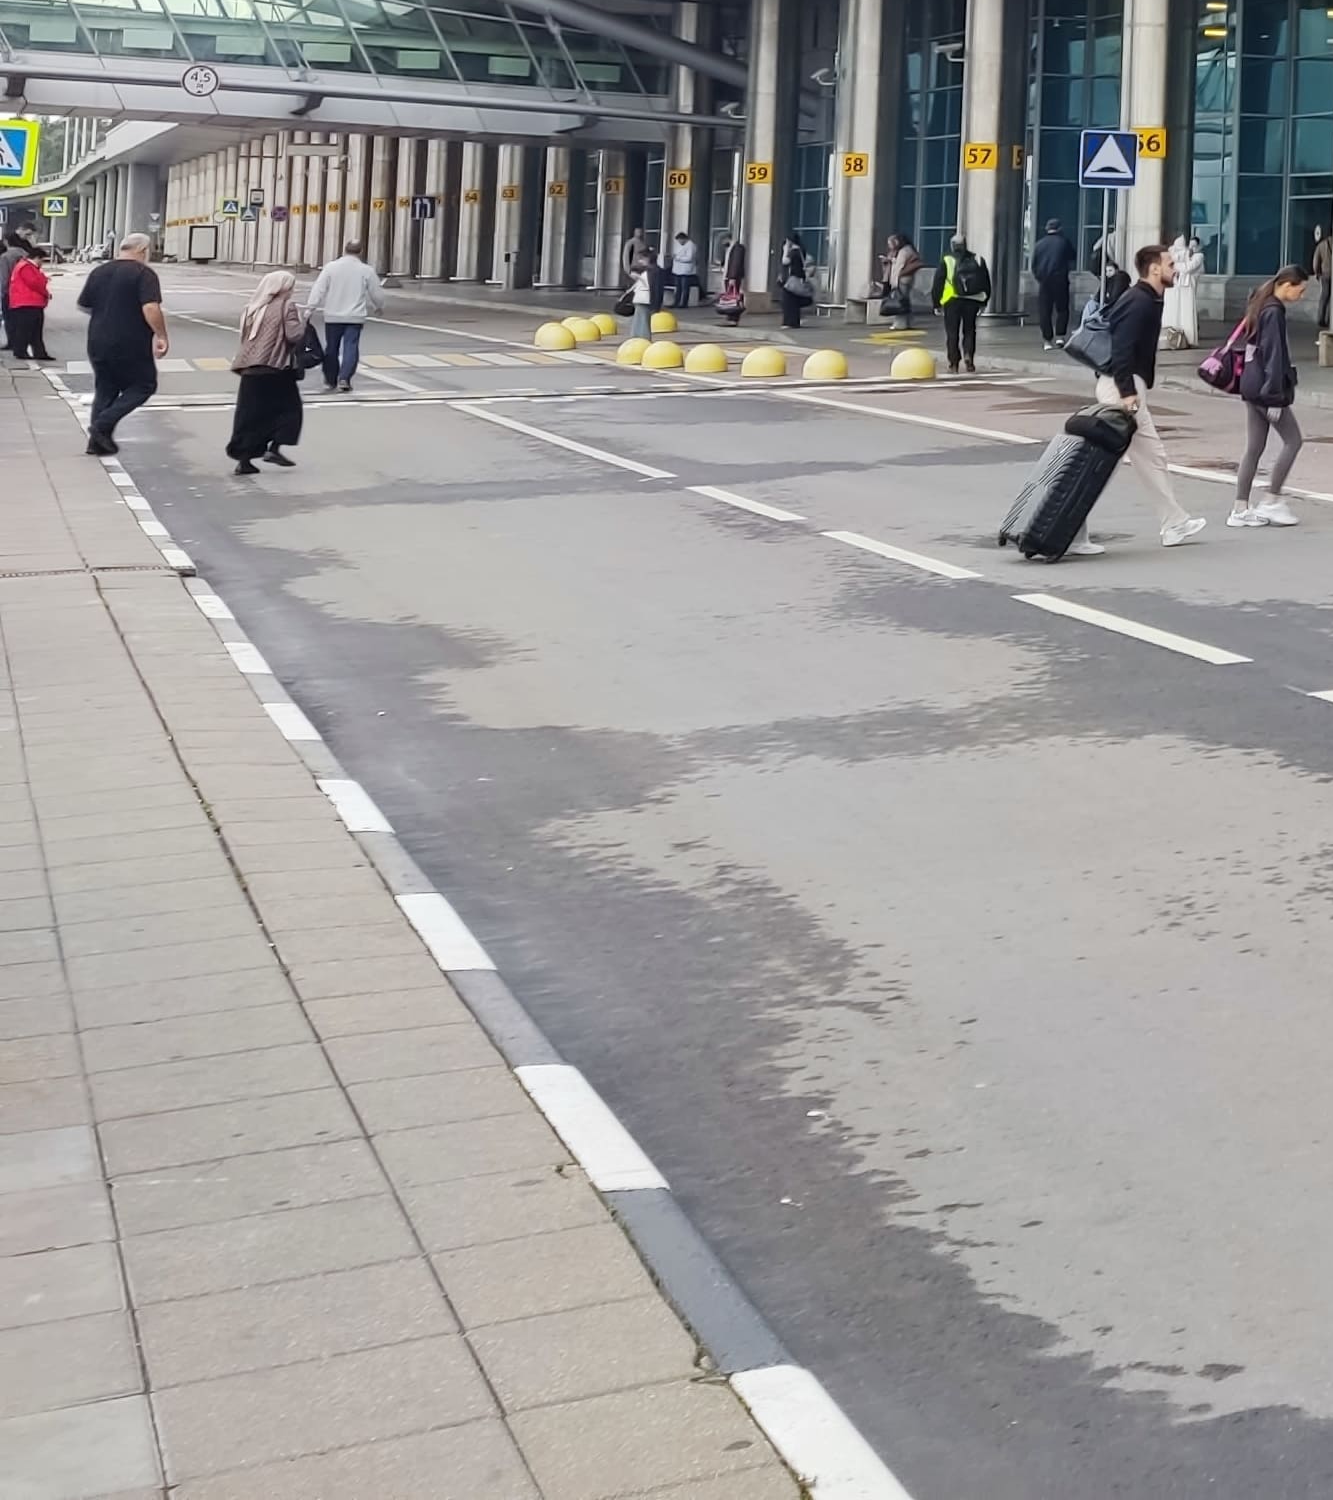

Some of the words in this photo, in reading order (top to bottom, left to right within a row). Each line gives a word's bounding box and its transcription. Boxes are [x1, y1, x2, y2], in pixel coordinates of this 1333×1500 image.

[967, 148, 992, 165] 57
[844, 157, 864, 172] 58
[669, 173, 687, 186] 60
[748, 166, 768, 180] 59
[550, 184, 563, 195] 62
[605, 180, 619, 192] 61
[502, 188, 515, 198] 63
